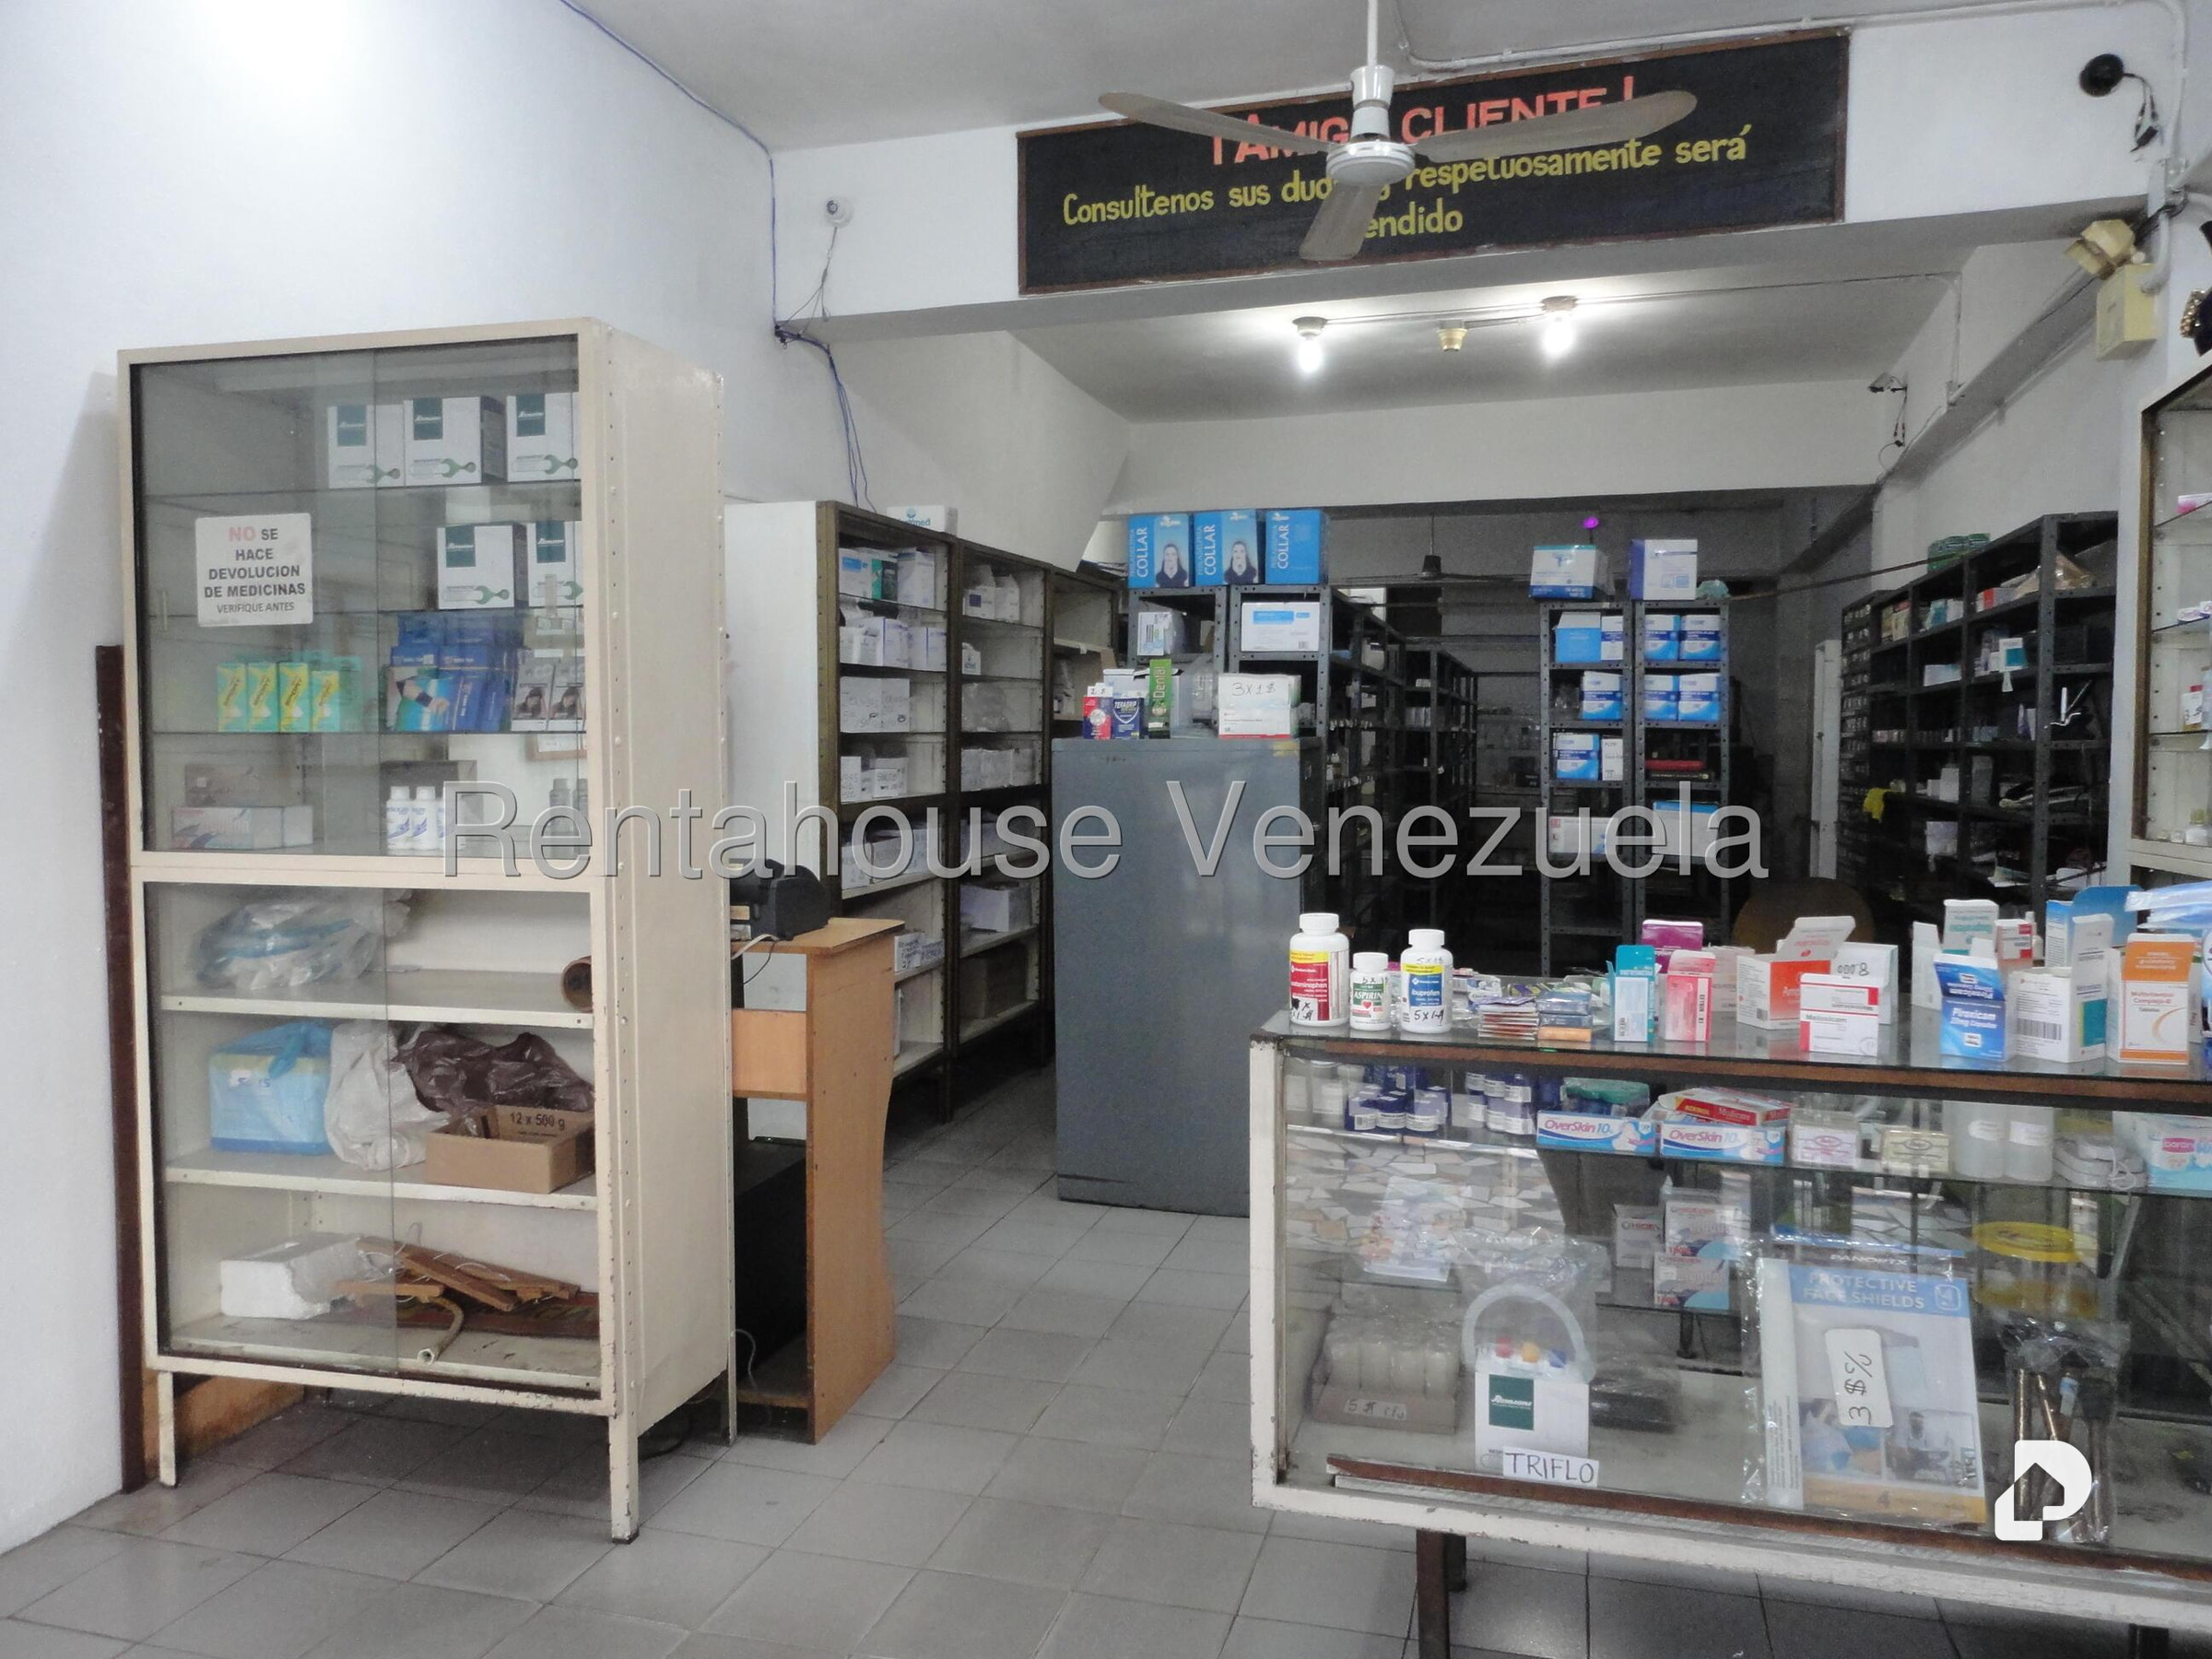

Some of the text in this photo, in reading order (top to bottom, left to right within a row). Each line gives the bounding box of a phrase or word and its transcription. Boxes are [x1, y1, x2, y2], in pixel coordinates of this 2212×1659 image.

[1063, 184, 1215, 225] Consultenos
[1229, 182, 1271, 208] sus
[1405, 135, 1662, 194] respetuosamente
[1675, 124, 1752, 164] será
[228, 525, 278, 542] NO SE
[235, 547, 274, 561] HACE
[1135, 526, 1148, 578] COLLAR
[1204, 524, 1217, 576] COLLAR
[1277, 524, 1289, 570] COLLAR
[208, 564, 300, 581] DEVOLUCION
[204, 582, 306, 598] DE MEDICINAS
[217, 601, 295, 614] VERIFIQUE ANTES
[1354, 991, 1383, 1000] ASPIRIN
[510, 1112, 522, 1125] 12
[535, 1112, 554, 1126] 500
[557, 1117, 565, 1131] g
[1544, 1119, 1611, 1134] OverSkin 10
[1669, 1129, 1723, 1143] OverSkin
[1809, 1271, 1918, 1293] PROTECTIVE
[1852, 1292, 1925, 1310] SHIELDS
[1504, 1452, 1594, 1483] TRIFLO
